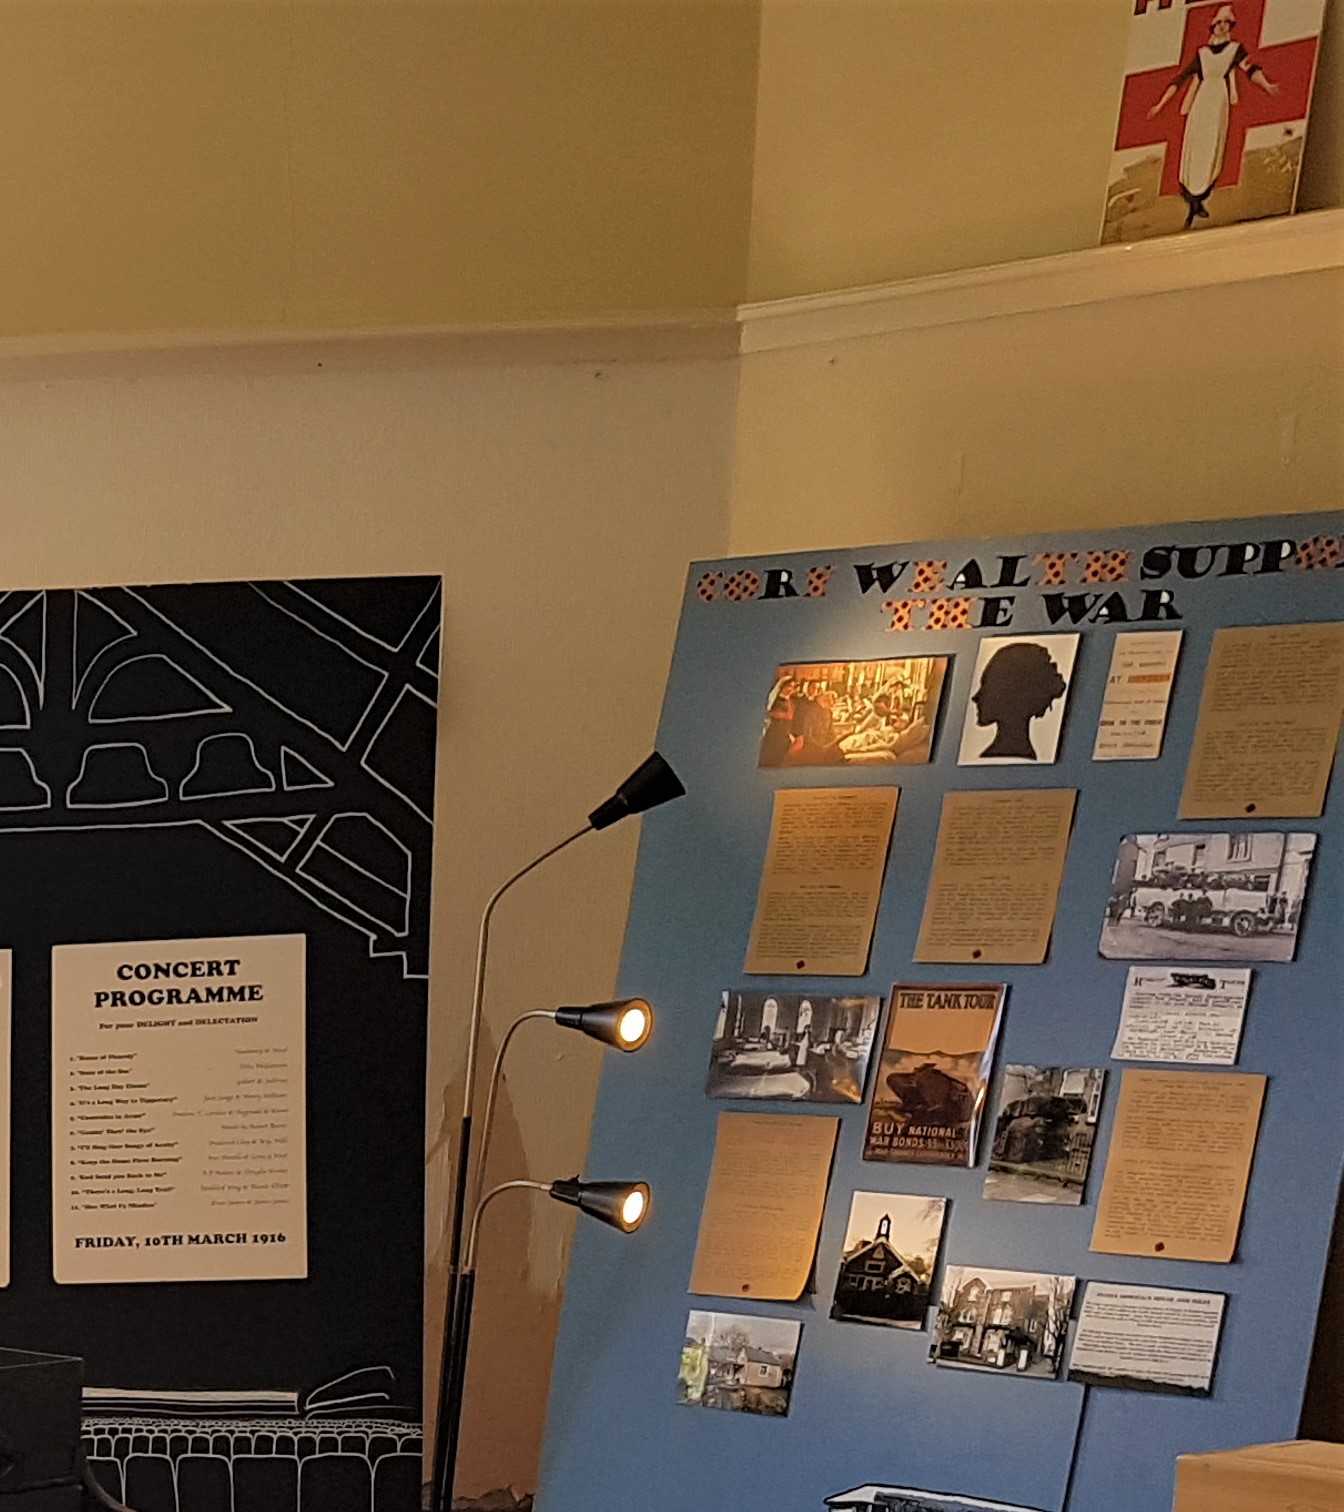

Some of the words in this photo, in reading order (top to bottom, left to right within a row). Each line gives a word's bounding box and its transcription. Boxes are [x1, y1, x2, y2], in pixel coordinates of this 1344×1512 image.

[697, 564, 837, 603] CORY
[853, 549, 1130, 595] WEALTH
[1140, 534, 1344, 580] SUPPO
[880, 595, 1016, 632] THE
[1041, 589, 1183, 625] WAR
[117, 959, 241, 981] CONCERT
[94, 984, 264, 1008] PROGRAMME
[899, 992, 924, 1010] THE
[926, 993, 962, 1010] TANK
[963, 992, 997, 1010] TOUR
[872, 1121, 906, 1136] BUY
[907, 1125, 957, 1139] NATIONAL
[75, 1236, 141, 1250] FRIDAY,
[145, 1235, 183, 1247] 10TH
[187, 1233, 247, 1245] MARCH
[252, 1232, 286, 1244] 1916
